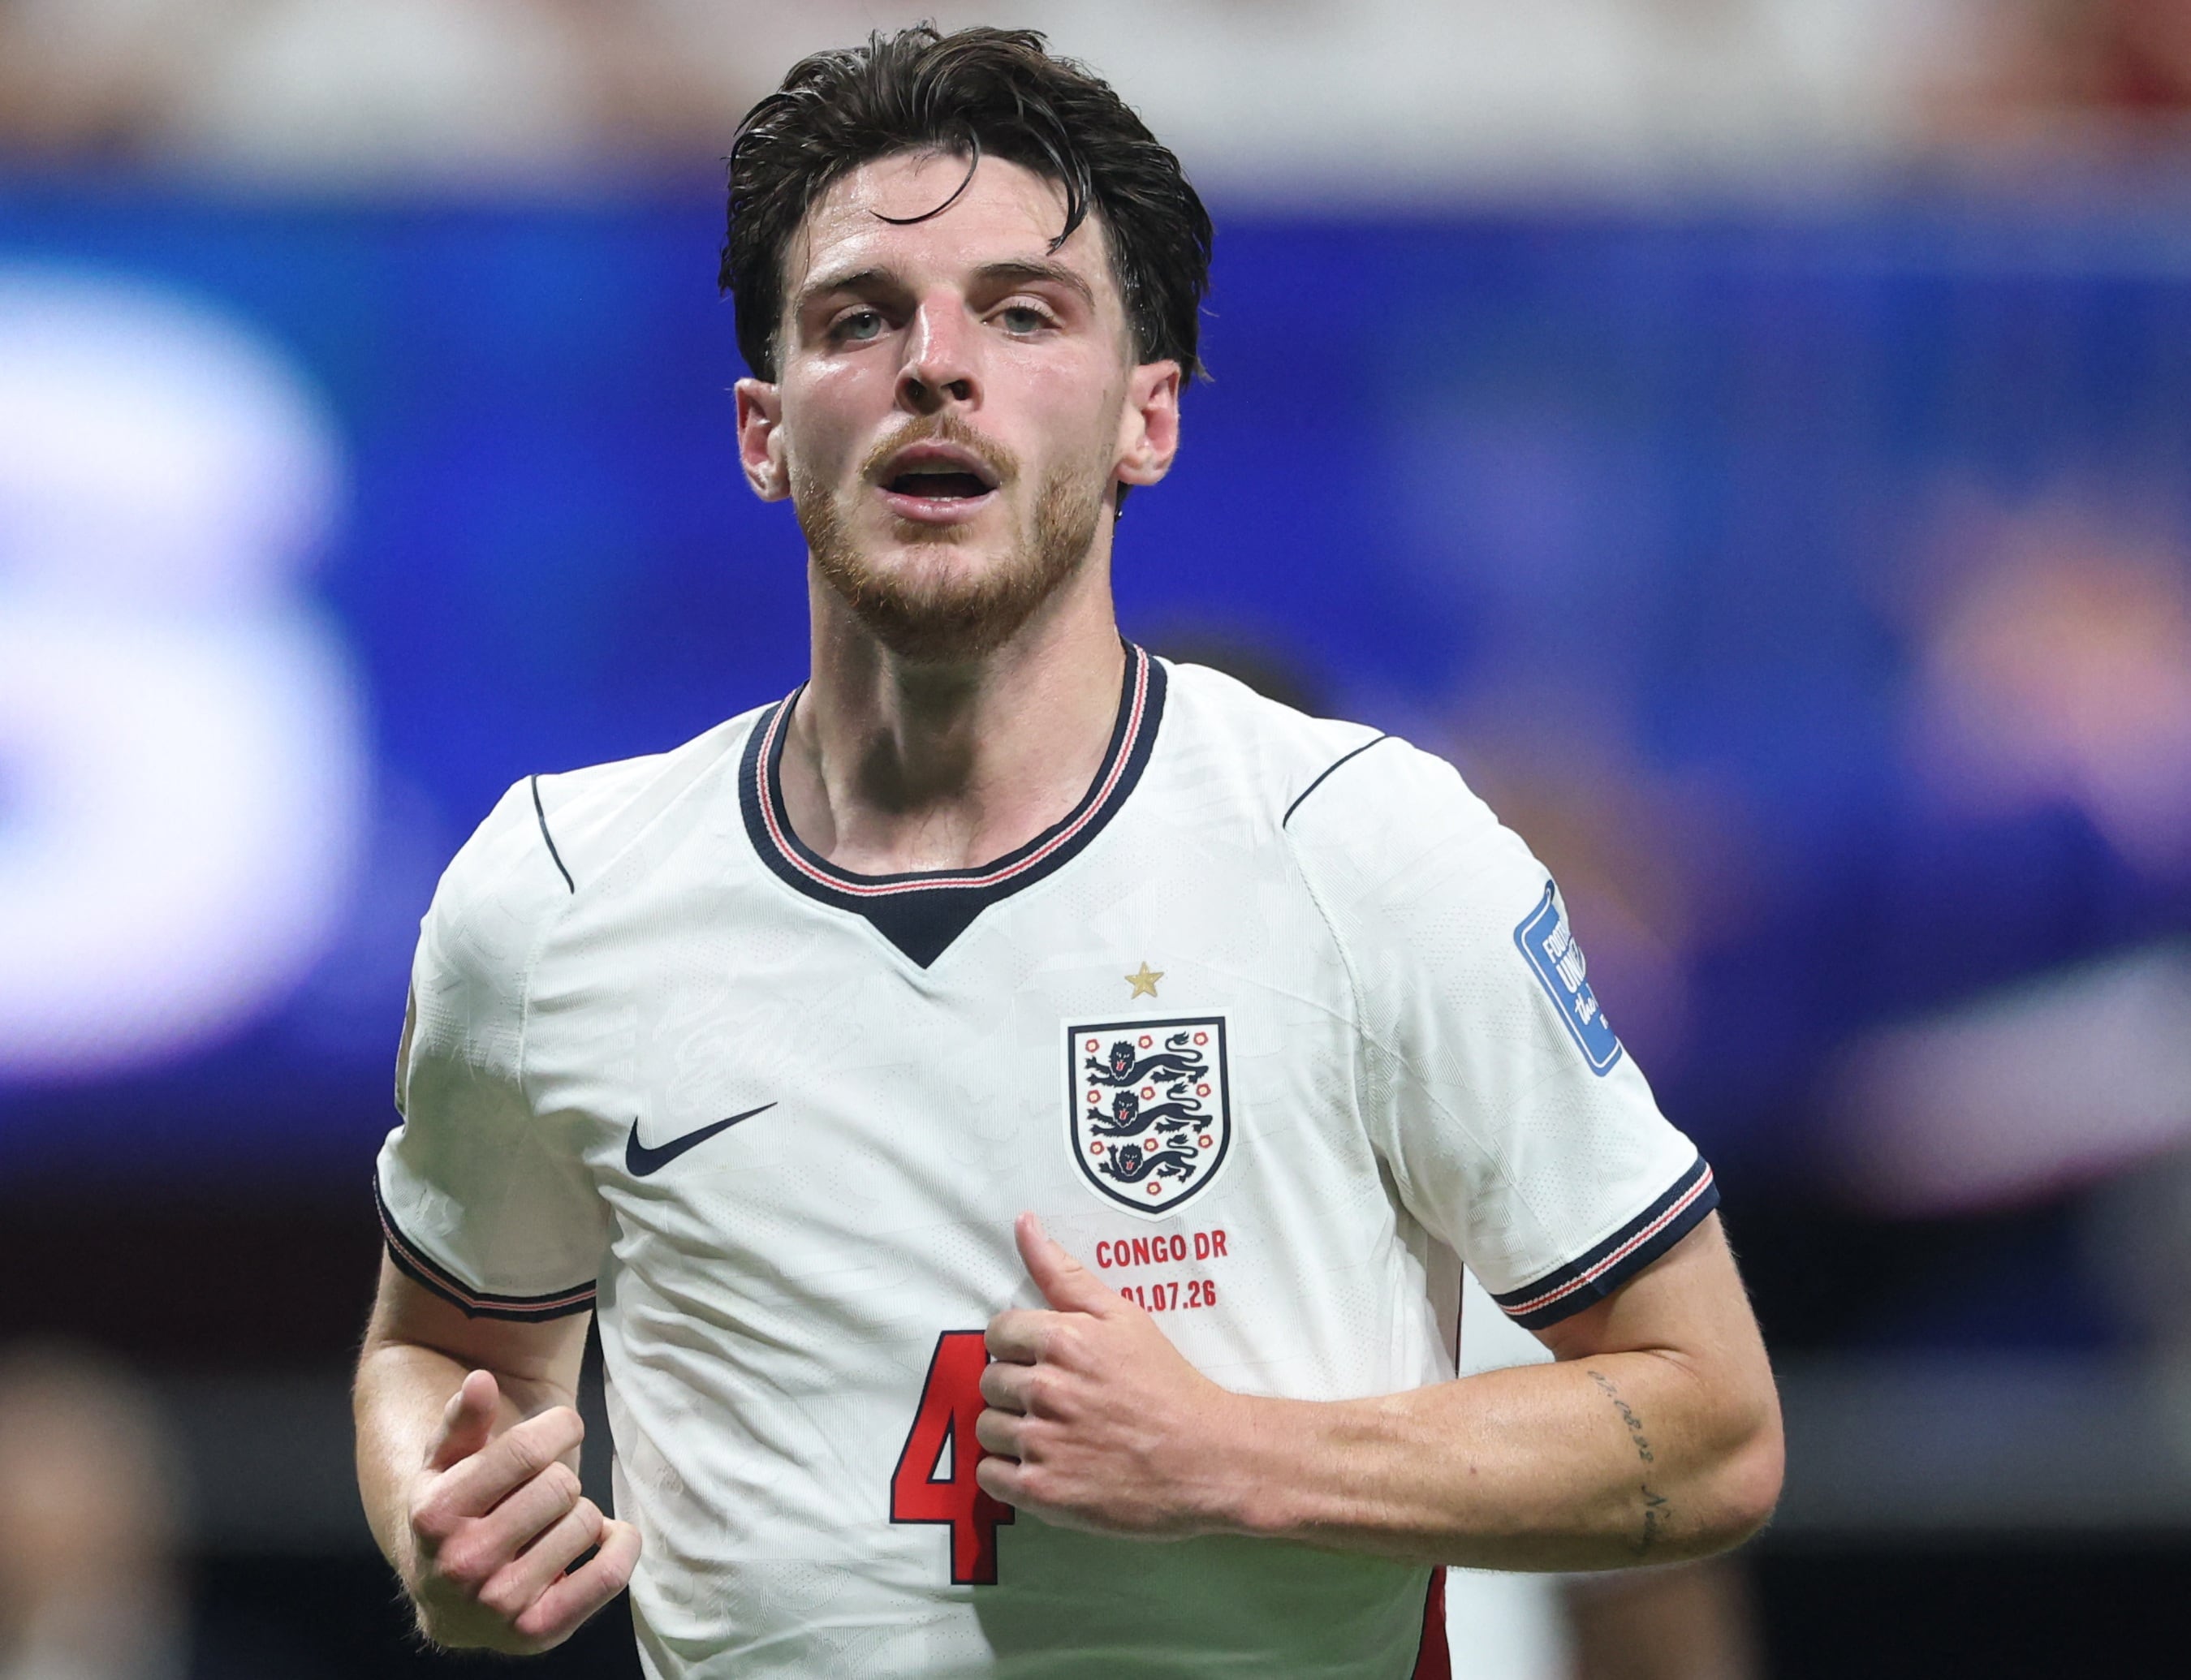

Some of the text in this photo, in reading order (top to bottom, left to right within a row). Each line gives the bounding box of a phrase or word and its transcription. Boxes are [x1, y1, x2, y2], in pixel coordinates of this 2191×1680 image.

[1542, 920, 1571, 963] FOOT
[1096, 1230, 1227, 1269] CONGO DR
[890, 1329, 1015, 1585] 4
